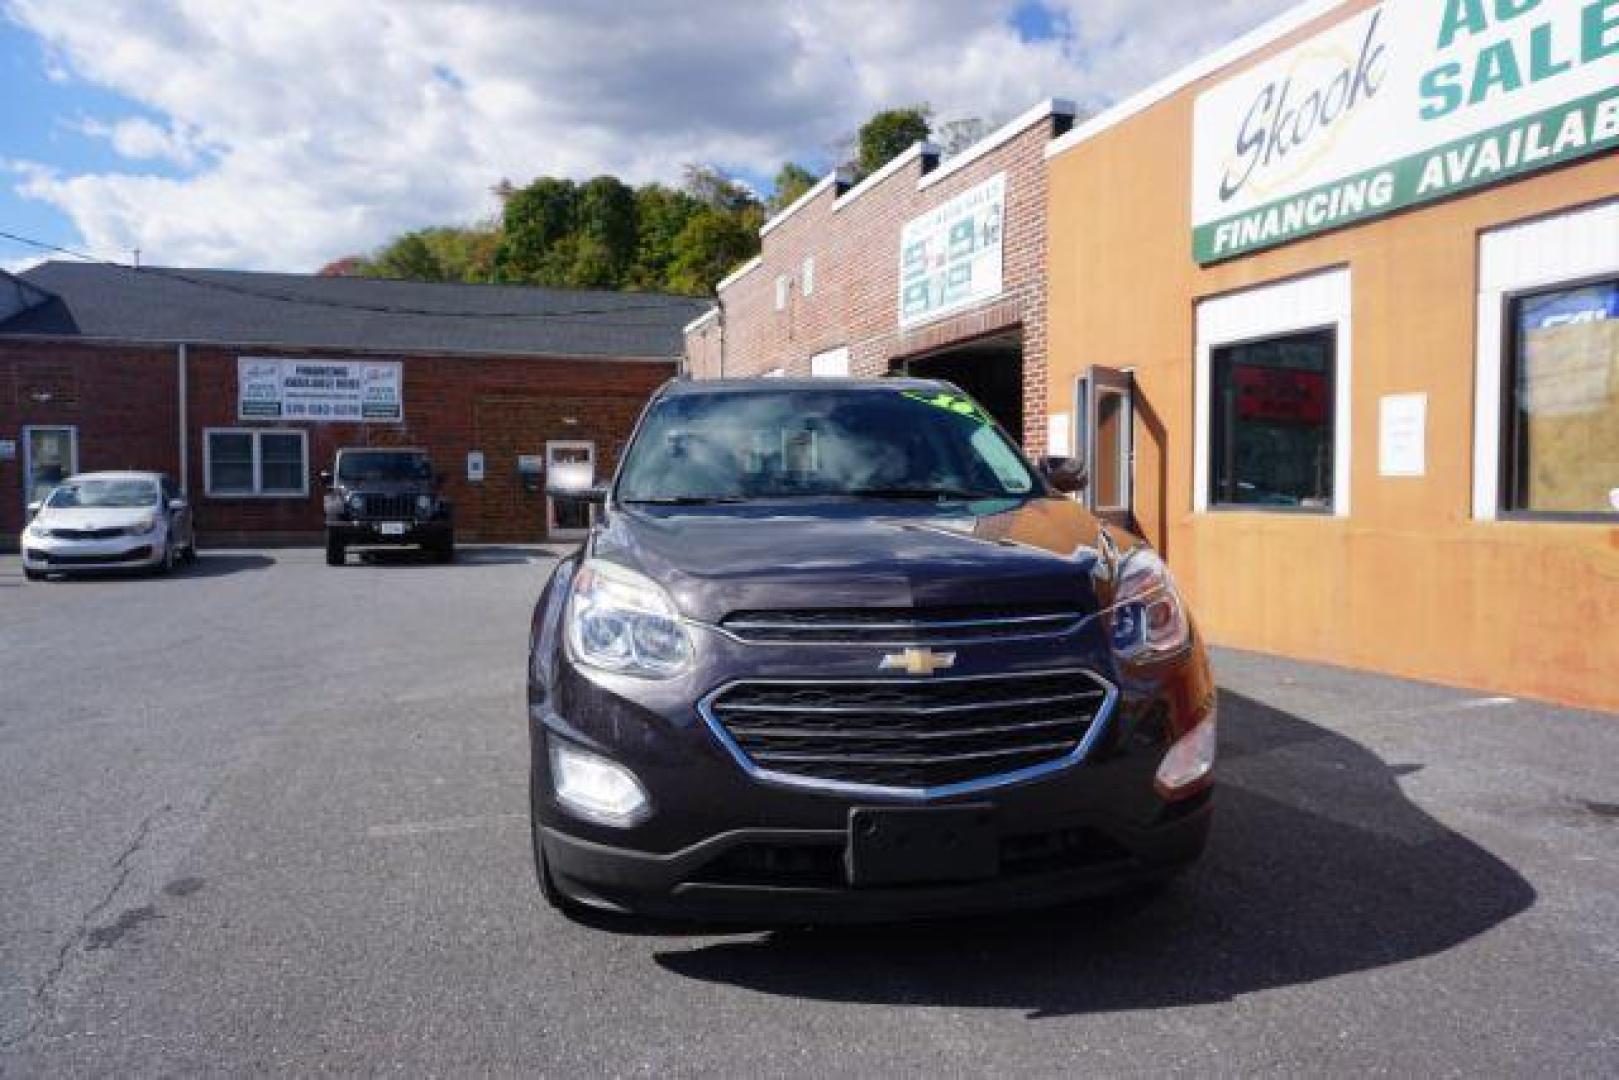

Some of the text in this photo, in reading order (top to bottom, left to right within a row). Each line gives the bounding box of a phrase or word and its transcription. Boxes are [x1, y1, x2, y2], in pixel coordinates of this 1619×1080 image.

[1213, 95, 1619, 254] FINANCING AVAILAB
[1219, 8, 1385, 201] Skook
